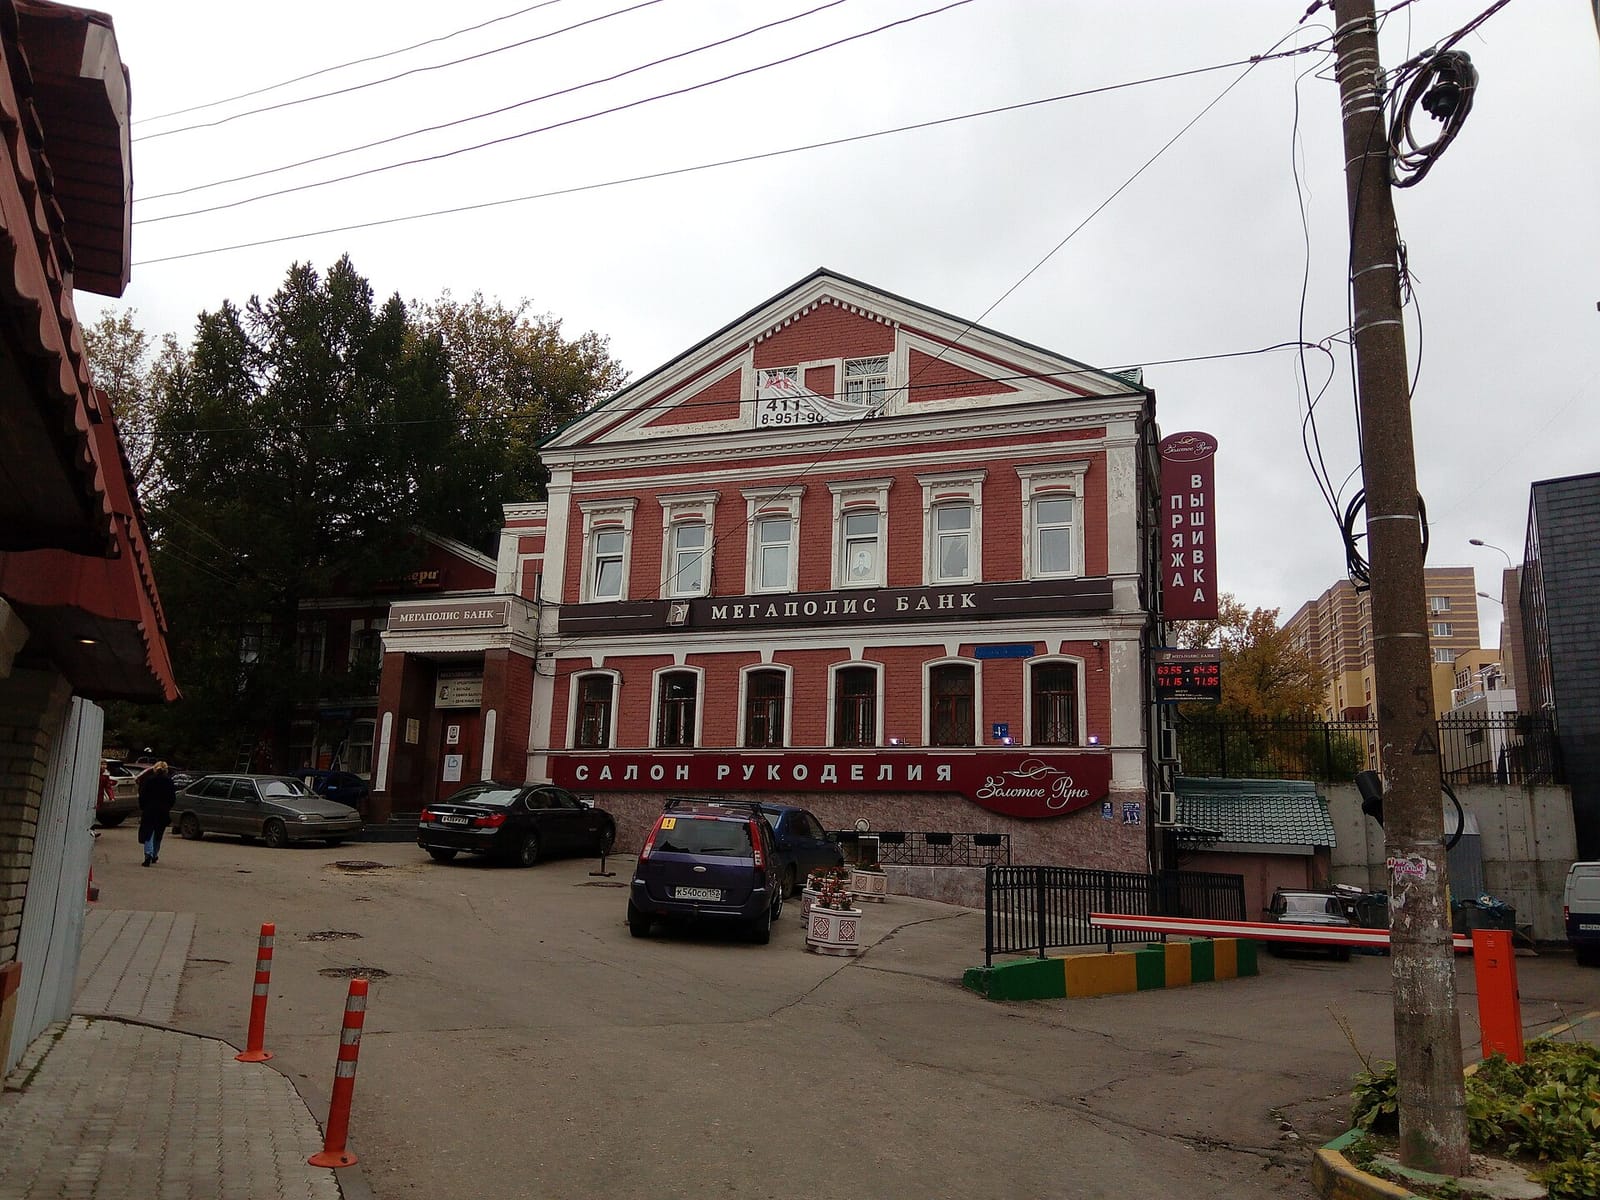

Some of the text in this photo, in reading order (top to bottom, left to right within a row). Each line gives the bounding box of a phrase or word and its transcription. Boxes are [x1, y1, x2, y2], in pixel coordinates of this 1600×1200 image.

[1171, 495, 1184, 587] ПРЯЖА
[1190, 474, 1205, 602] ВЫШИВКА
[400, 609, 494, 622] МЕГАПОЛИС БАНК
[711, 592, 977, 620] МЕГАПОЛИС БАНК
[1157, 665, 1182, 675] 63.55
[1158, 677, 1183, 686] 71.15
[575, 764, 952, 783] САЛОН РУКОДЕЛИЯ
[976, 776, 1090, 809] Золотое Руно
